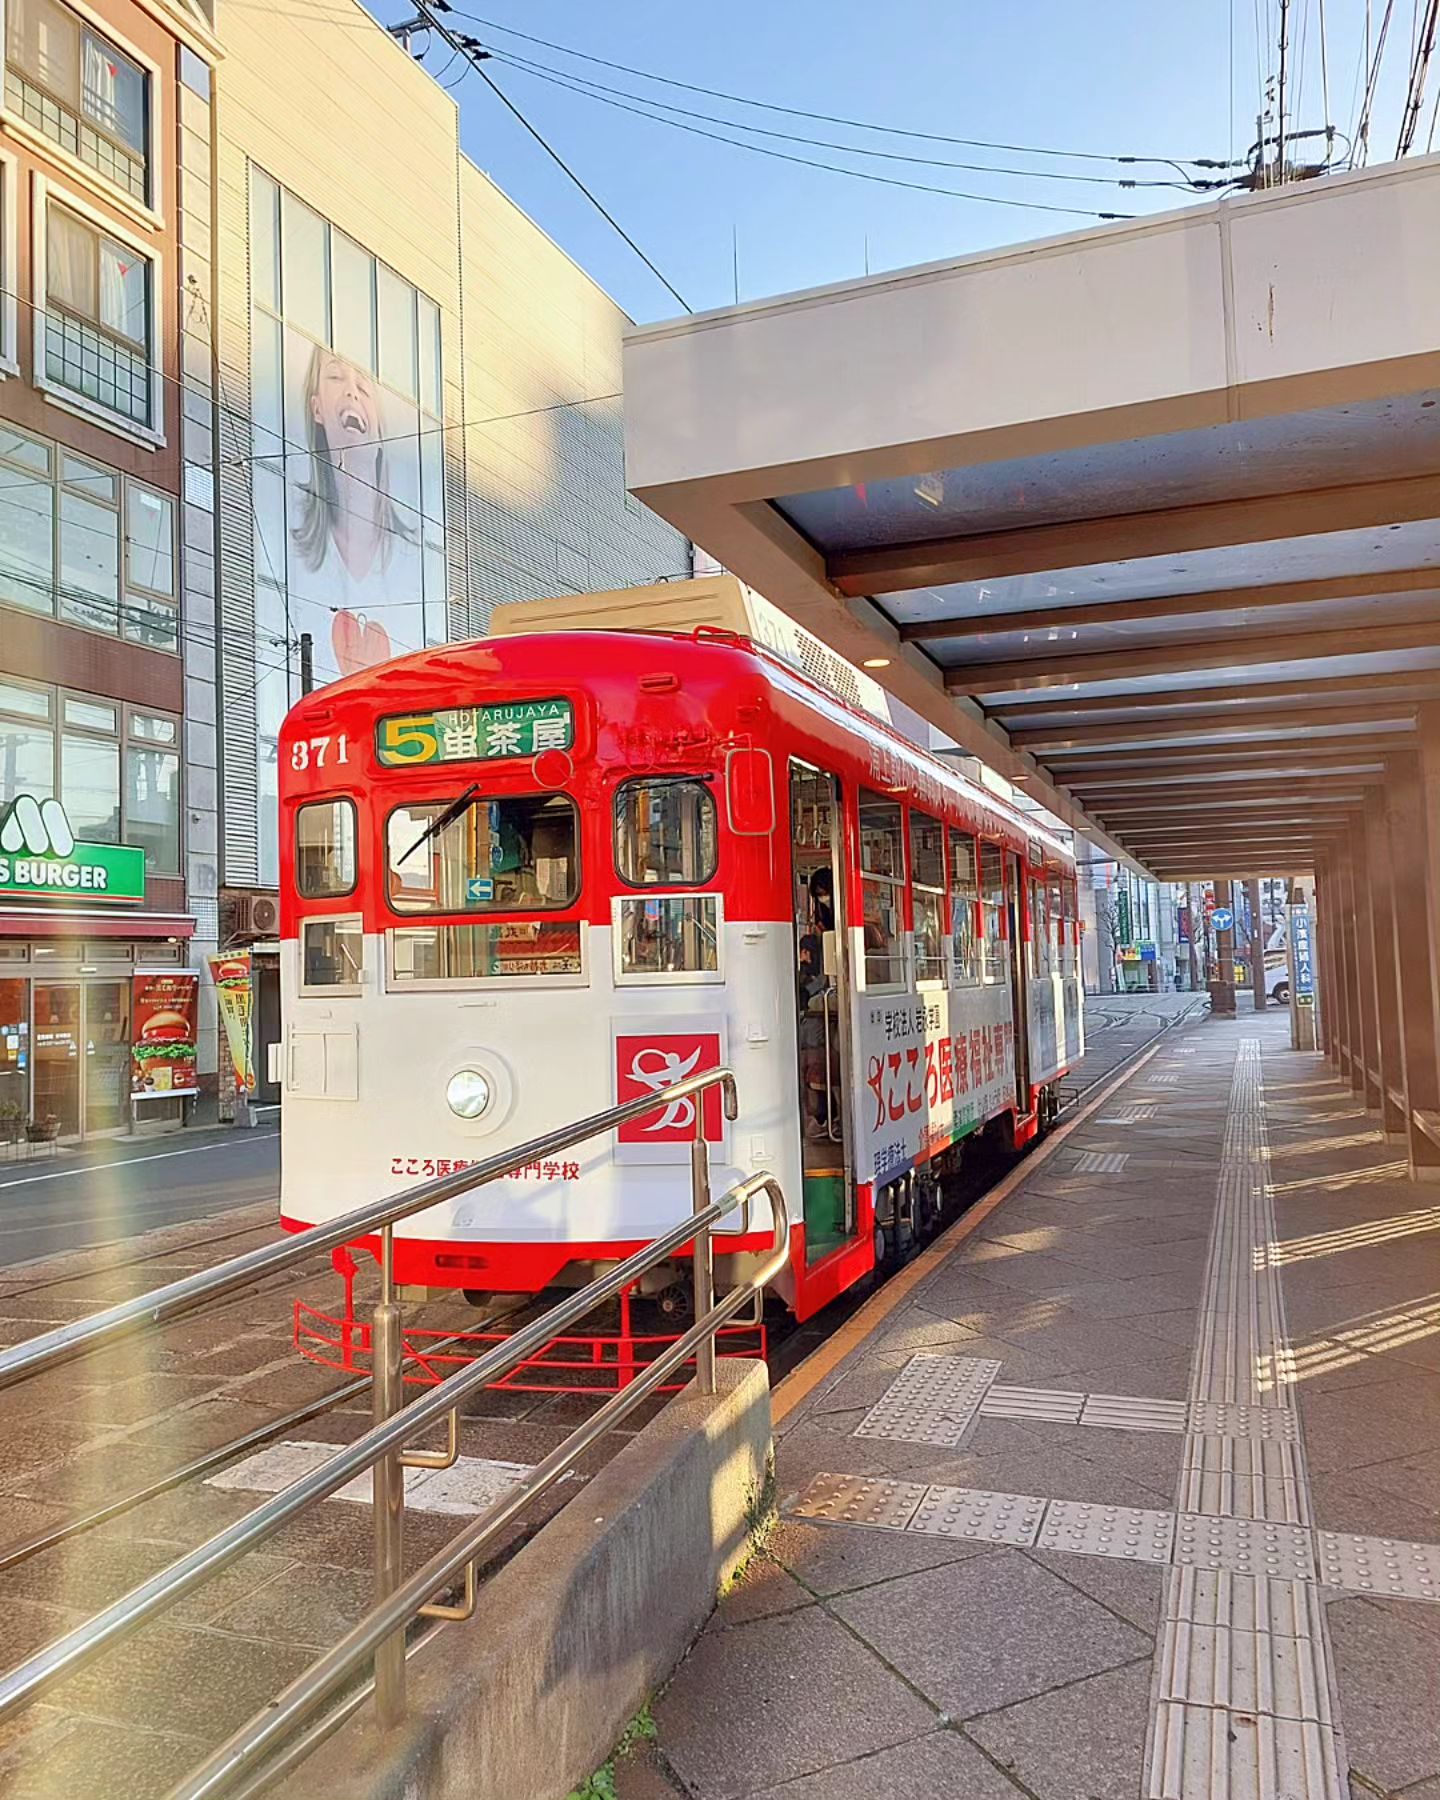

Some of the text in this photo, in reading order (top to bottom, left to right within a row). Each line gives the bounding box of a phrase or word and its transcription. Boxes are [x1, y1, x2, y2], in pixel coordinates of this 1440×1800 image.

[448, 704, 559, 727] HOTARUJAYA
[290, 734, 350, 771] 371
[382, 717, 568, 765] 5 蛍茶屋
[15, 860, 108, 889] BURGER
[391, 1158, 580, 1181] こころ医療専門学校
